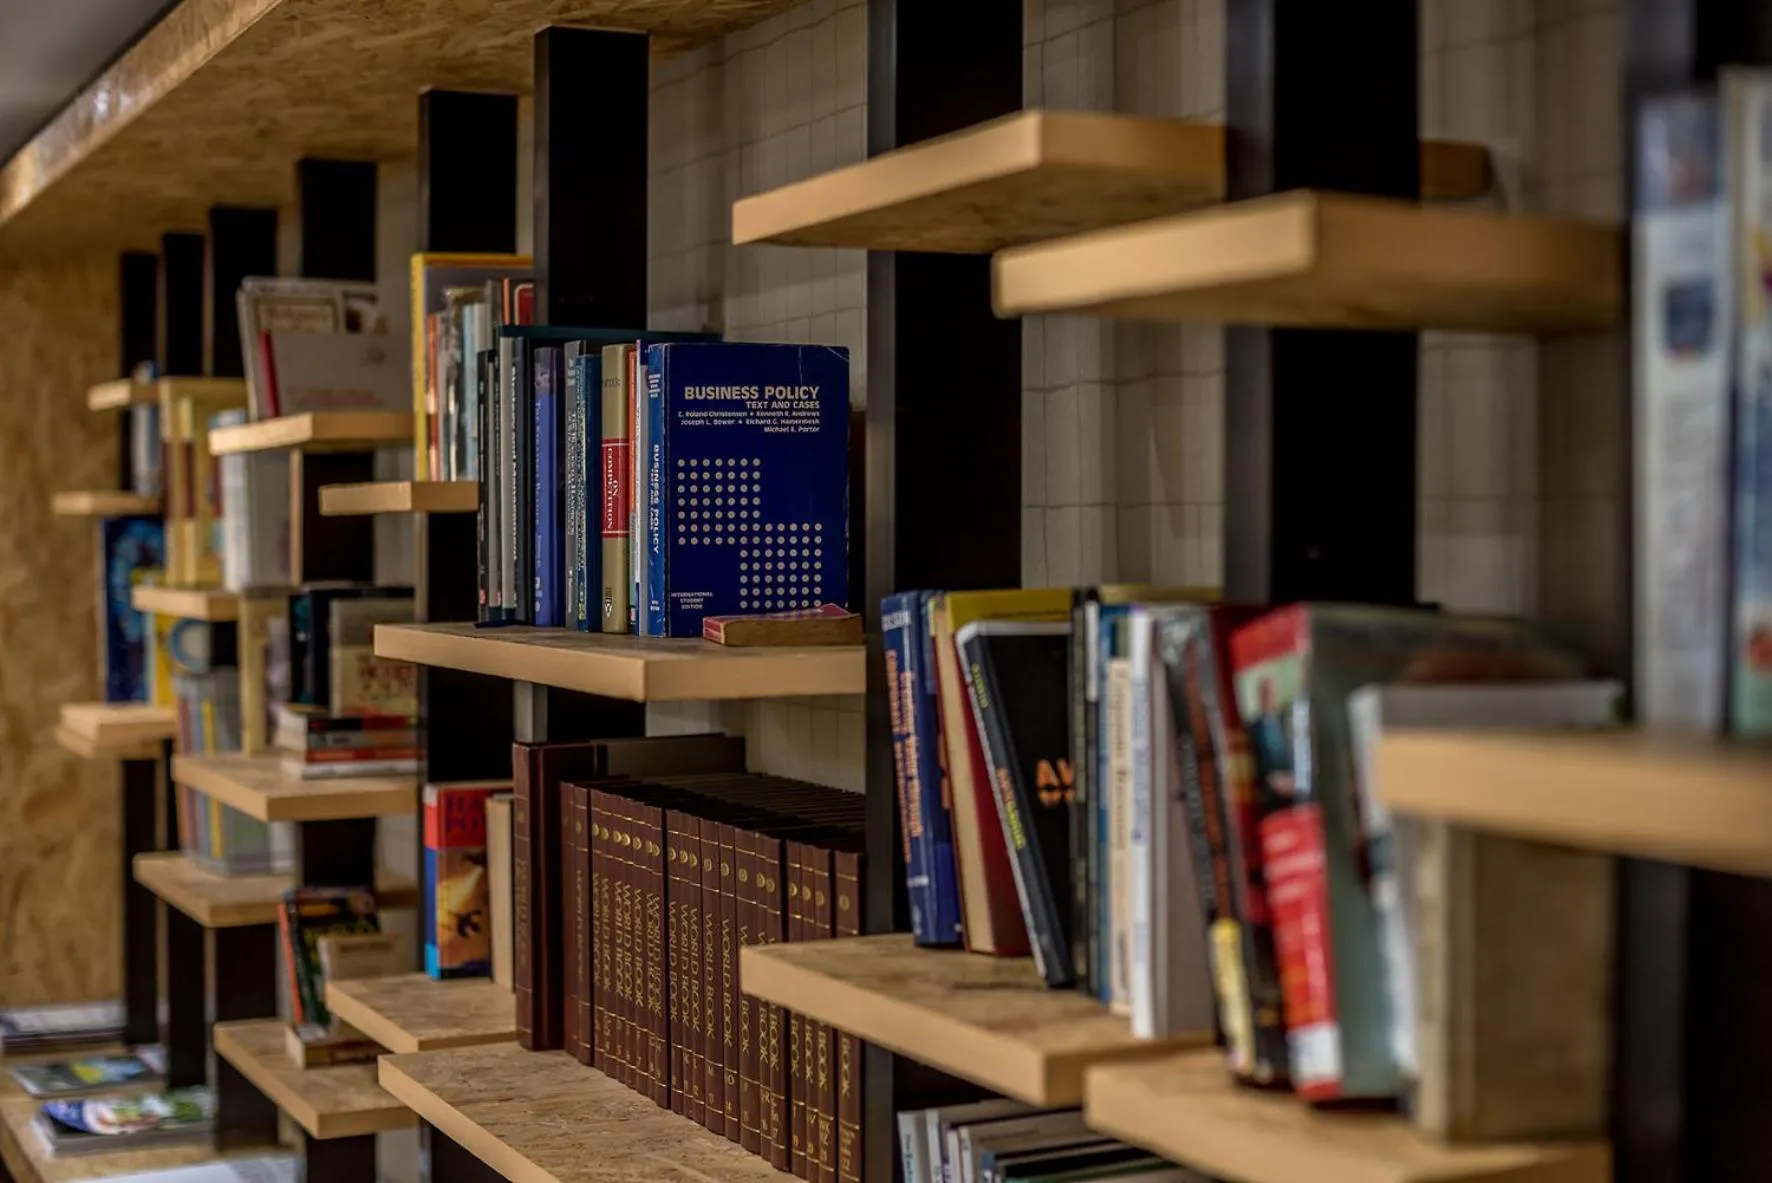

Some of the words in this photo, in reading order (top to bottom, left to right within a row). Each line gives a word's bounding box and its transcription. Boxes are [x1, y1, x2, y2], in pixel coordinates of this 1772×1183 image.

[684, 386, 759, 399] BUSINESS
[764, 386, 820, 399] POLICY
[746, 401, 768, 409] TEXT
[771, 401, 790, 409] AND
[793, 401, 820, 409] CASES
[612, 480, 619, 496] ON
[904, 736, 918, 777] Value
[634, 889, 643, 952] WORLD
[669, 901, 677, 966] WORLD
[680, 904, 689, 970] WORLD
[690, 908, 699, 975] WORLD
[705, 913, 713, 981] WORLD
[722, 919, 731, 987] WORLD
[635, 956, 644, 1008] BOOK
[670, 970, 678, 1023] BOOK
[681, 974, 690, 1027] BOOK
[691, 979, 700, 1032] BOOK
[706, 985, 715, 1040] BOOK
[723, 992, 732, 1048] BOOK
[741, 1000, 750, 1056] BOOK
[759, 1007, 769, 1063] BOOK
[769, 1014, 779, 1070] BOOK
[791, 1019, 800, 1077] BOOK
[818, 1031, 829, 1091] BOOK
